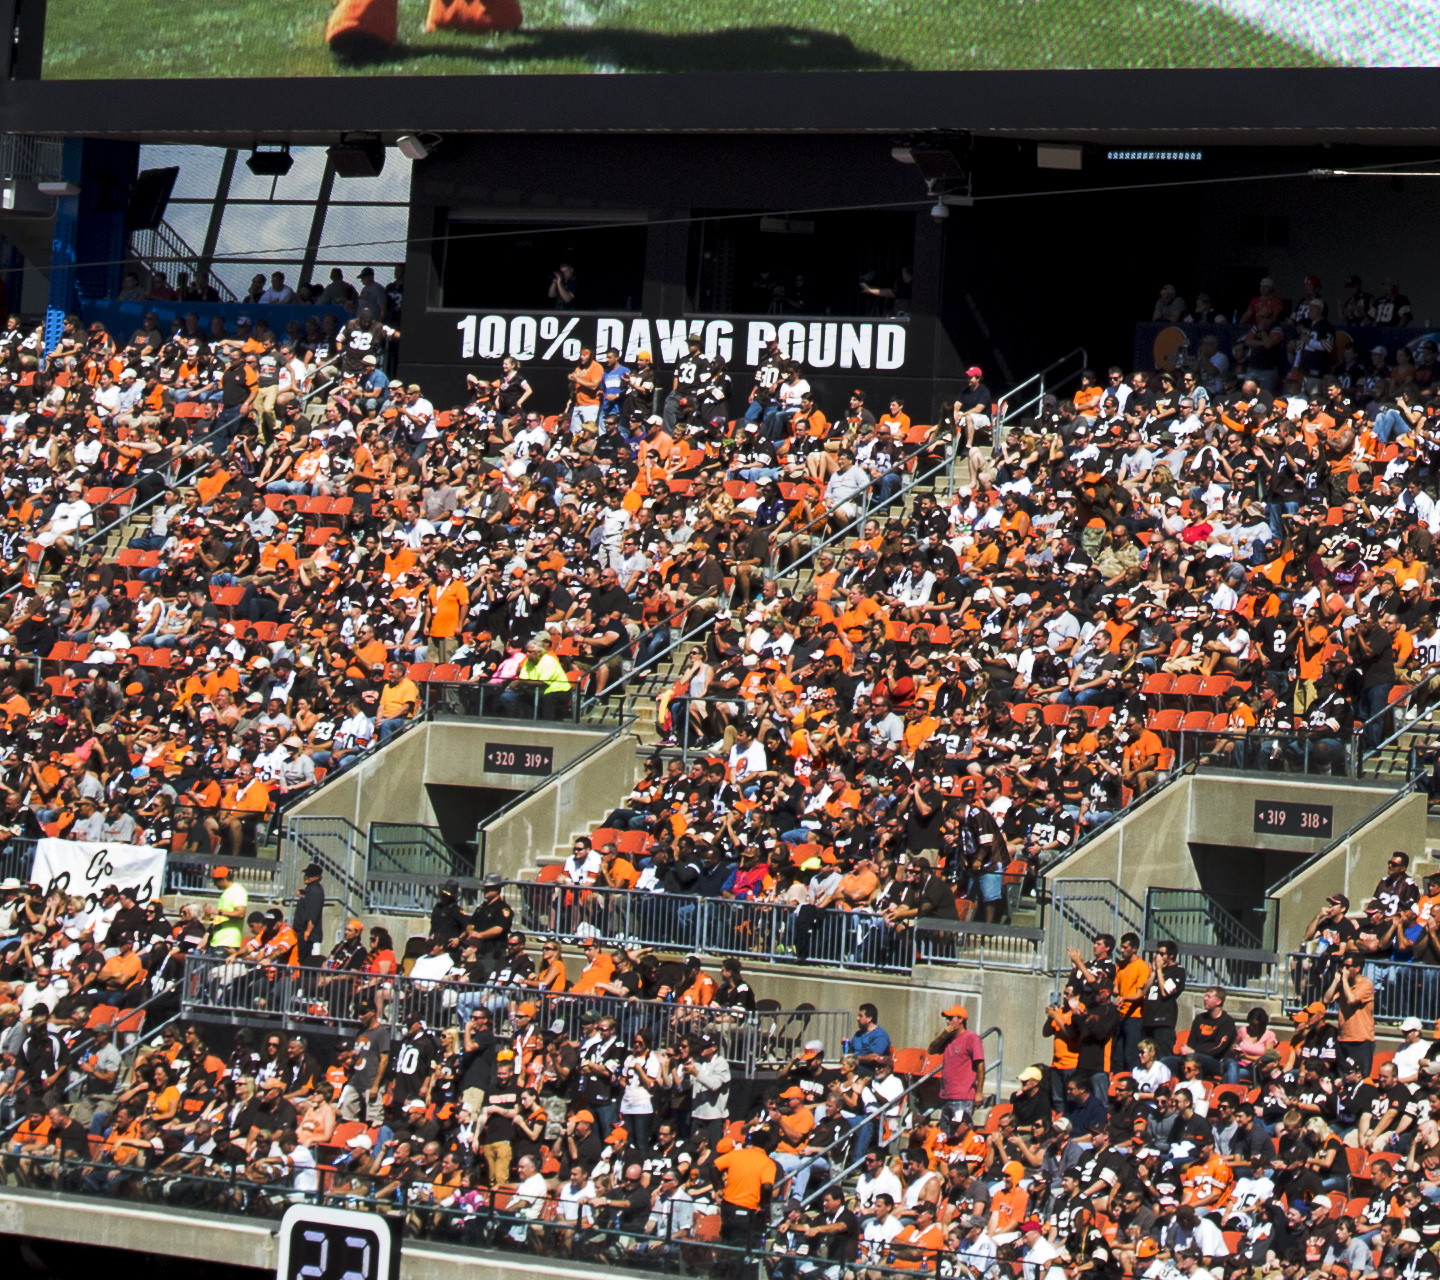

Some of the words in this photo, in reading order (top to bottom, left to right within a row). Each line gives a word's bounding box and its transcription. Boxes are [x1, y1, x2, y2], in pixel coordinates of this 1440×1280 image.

[457, 315, 580, 361] 100%
[595, 317, 733, 363] DAWG
[746, 320, 907, 370] POUND
[1273, 629, 1286, 652] 2
[495, 751, 515, 766] 320
[524, 753, 542, 768] 319
[1267, 809, 1286, 826] 319
[1300, 812, 1320, 829] 318
[86, 849, 114, 886] Go
[397, 1043, 419, 1075] 10
